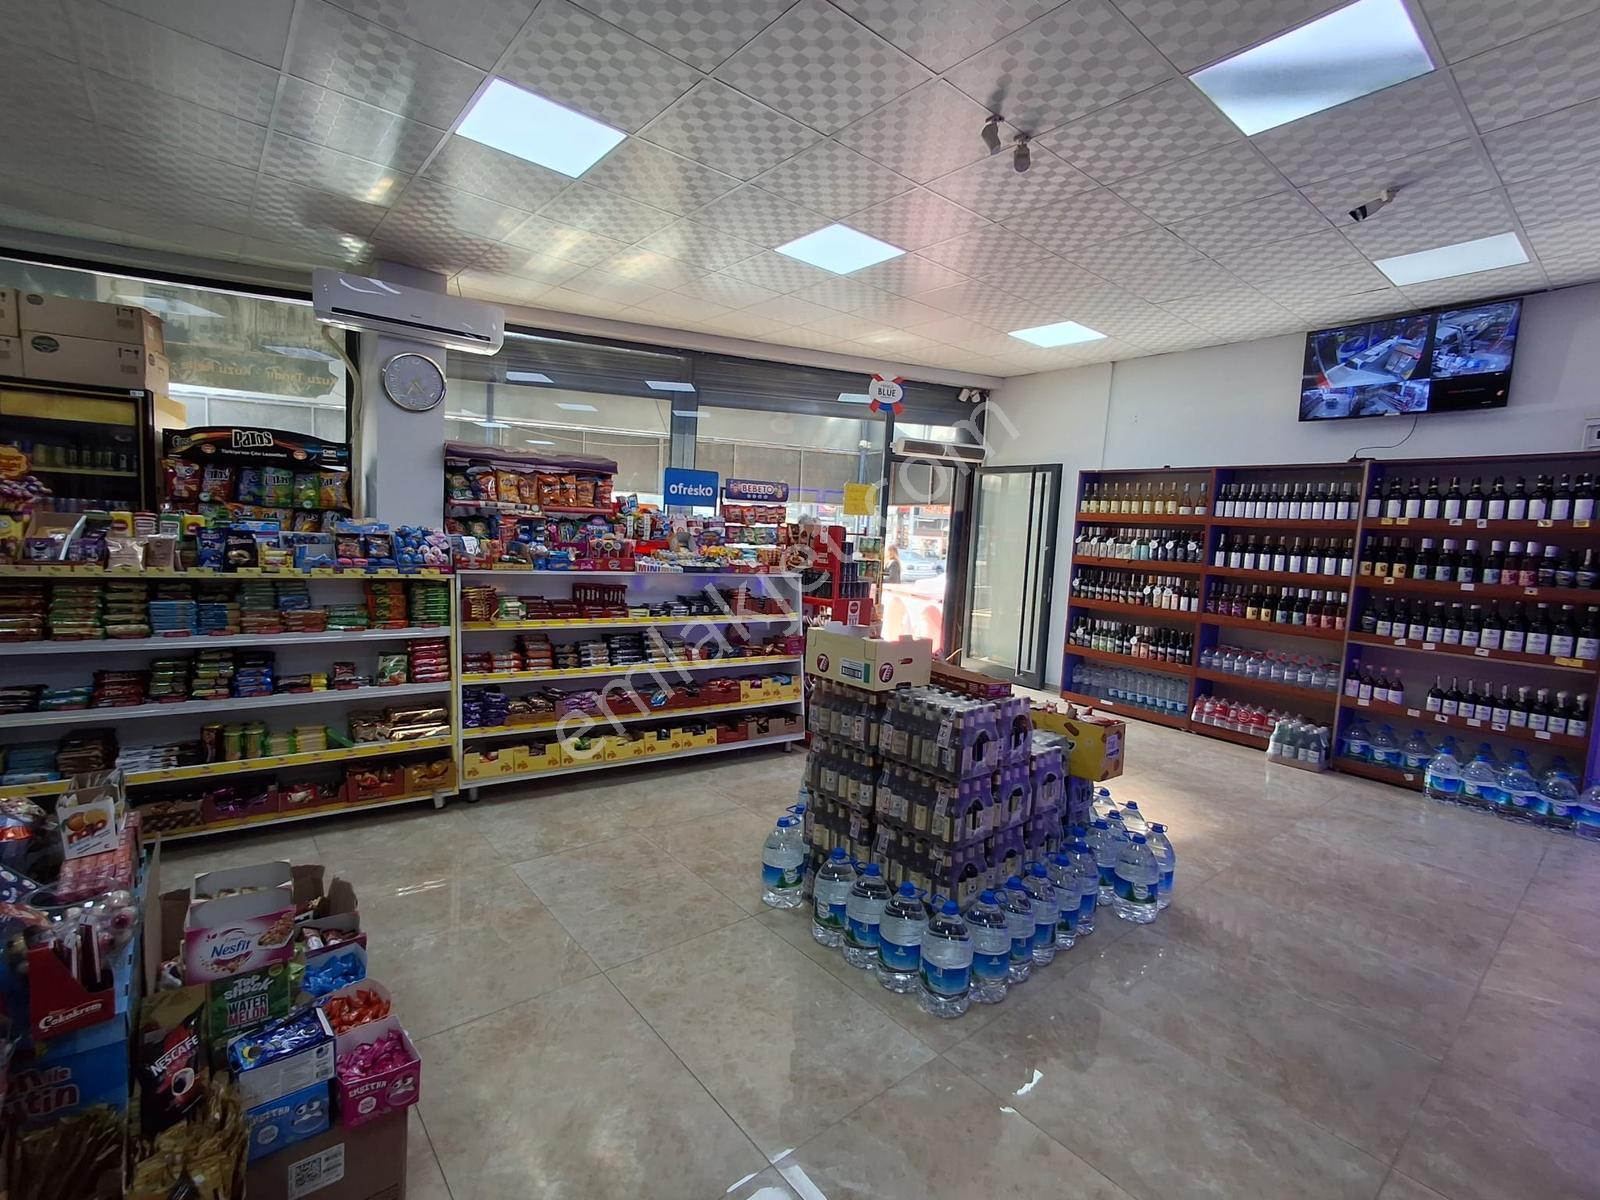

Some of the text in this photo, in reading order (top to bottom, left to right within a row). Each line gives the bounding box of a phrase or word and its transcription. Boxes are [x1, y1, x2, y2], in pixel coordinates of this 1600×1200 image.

[877, 387, 897, 397] BLUE
[232, 429, 274, 448] Patos
[741, 483, 774, 495] BEBETO
[211, 940, 251, 959] Nesfit
[228, 995, 267, 1014] WATER
[228, 1007, 267, 1026] MELON
